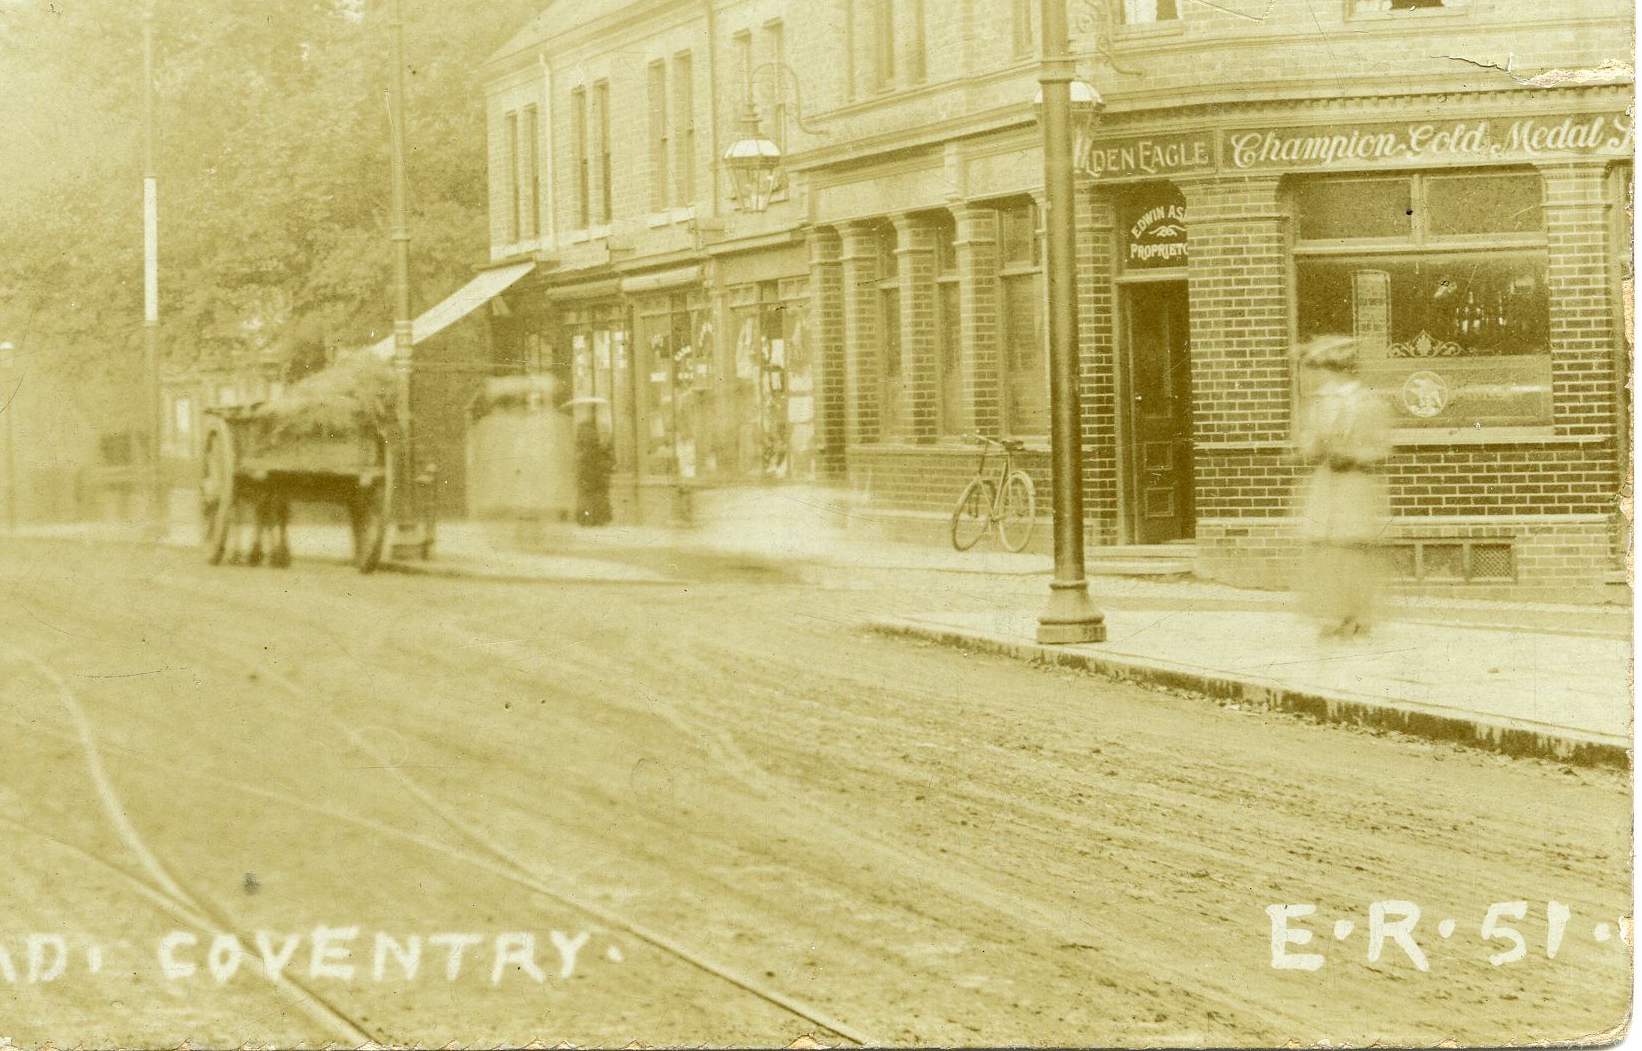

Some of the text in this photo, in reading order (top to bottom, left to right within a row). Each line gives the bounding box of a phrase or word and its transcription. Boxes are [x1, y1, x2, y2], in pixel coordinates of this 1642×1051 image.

[1139, 140, 1208, 174] EAGLE
[1230, 129, 1408, 169] Champion
[1407, 121, 1486, 161] Gold
[1490, 116, 1605, 155] Medal
[1131, 205, 1165, 239] EDWIN
